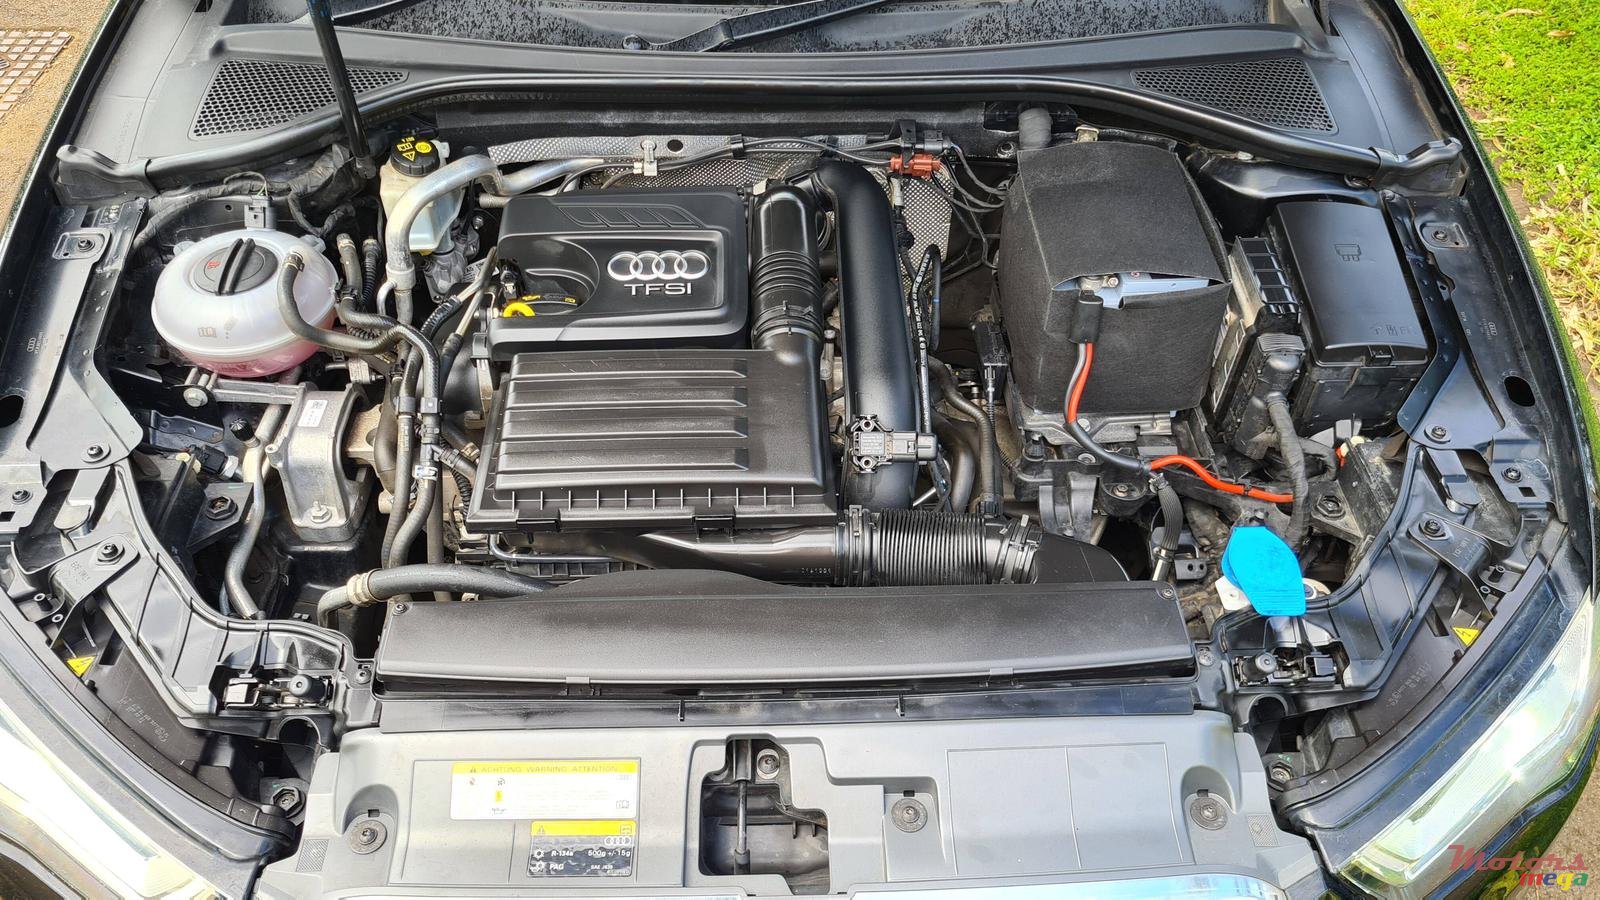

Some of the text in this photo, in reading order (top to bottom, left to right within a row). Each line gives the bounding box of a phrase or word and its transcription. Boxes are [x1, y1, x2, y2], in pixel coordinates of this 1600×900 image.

[624, 282, 692, 296] TFSI
[572, 765, 618, 773] ATTENTION
[551, 849, 574, 857] R-134a
[588, 849, 606, 858] 500g
